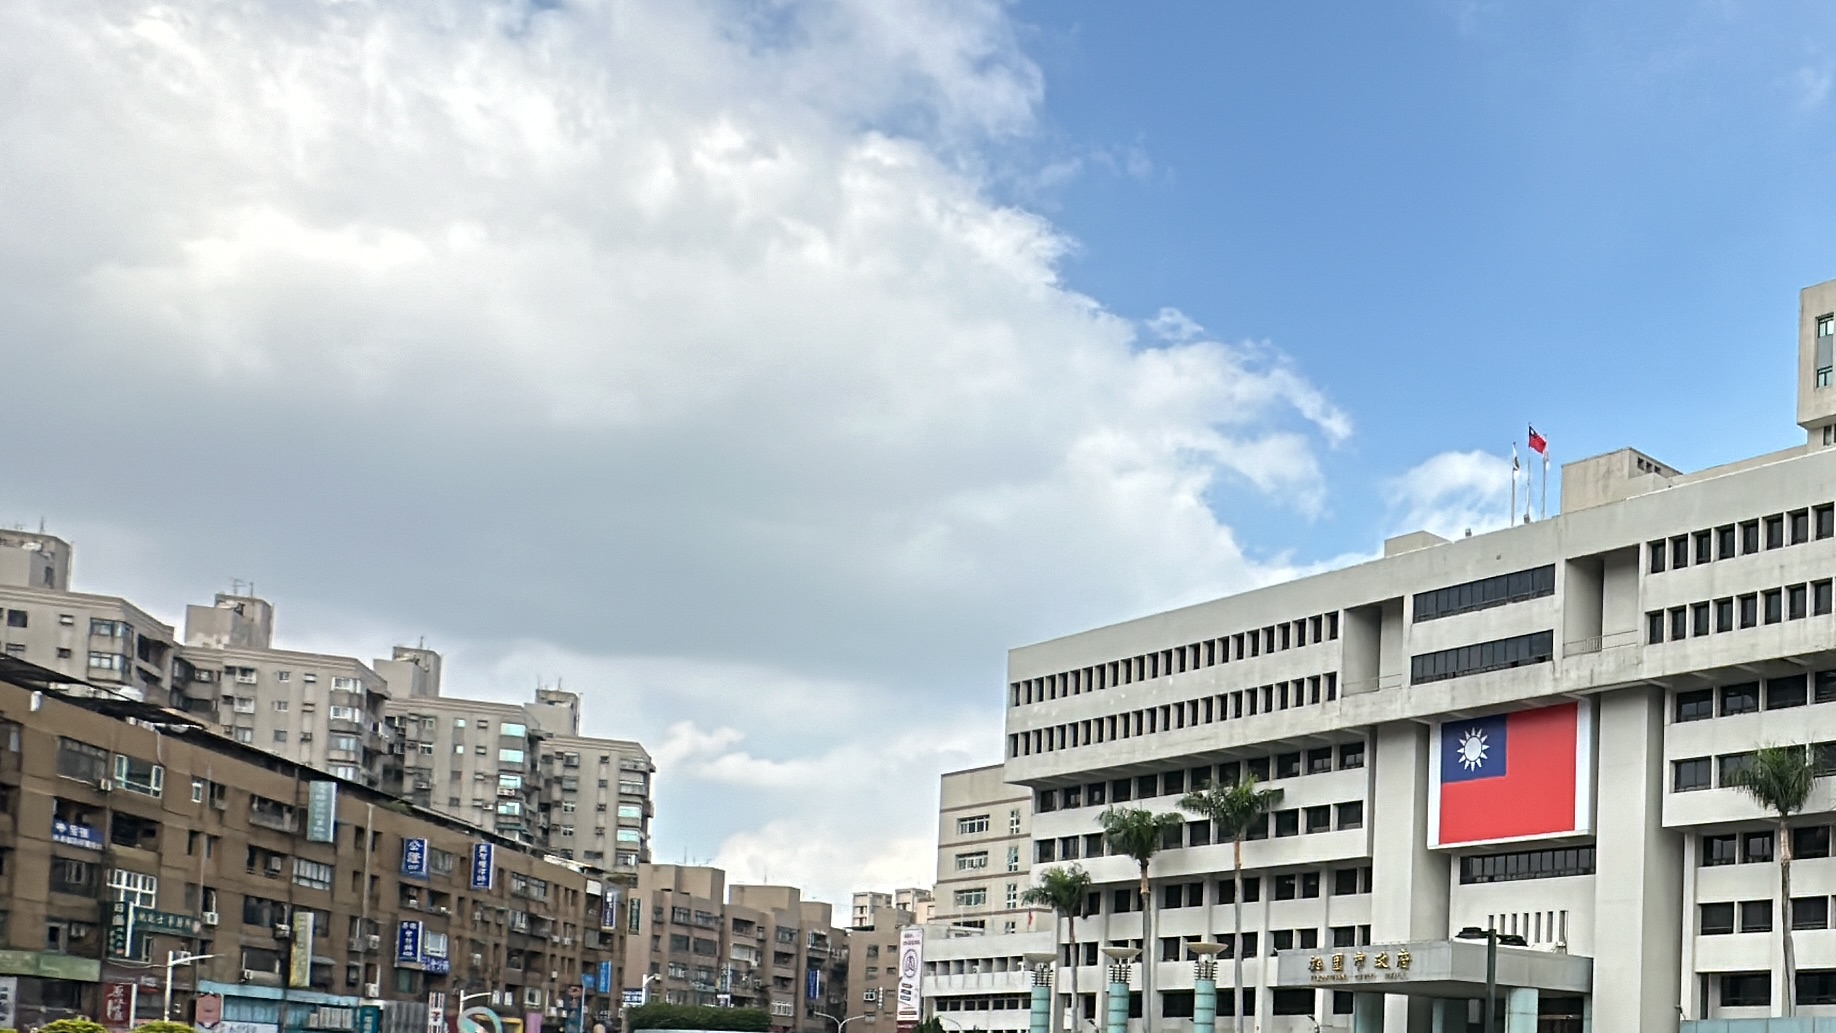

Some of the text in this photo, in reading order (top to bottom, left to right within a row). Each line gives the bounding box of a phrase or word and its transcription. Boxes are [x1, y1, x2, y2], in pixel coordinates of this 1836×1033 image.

[1308, 948, 1412, 972] 桃園市政府
